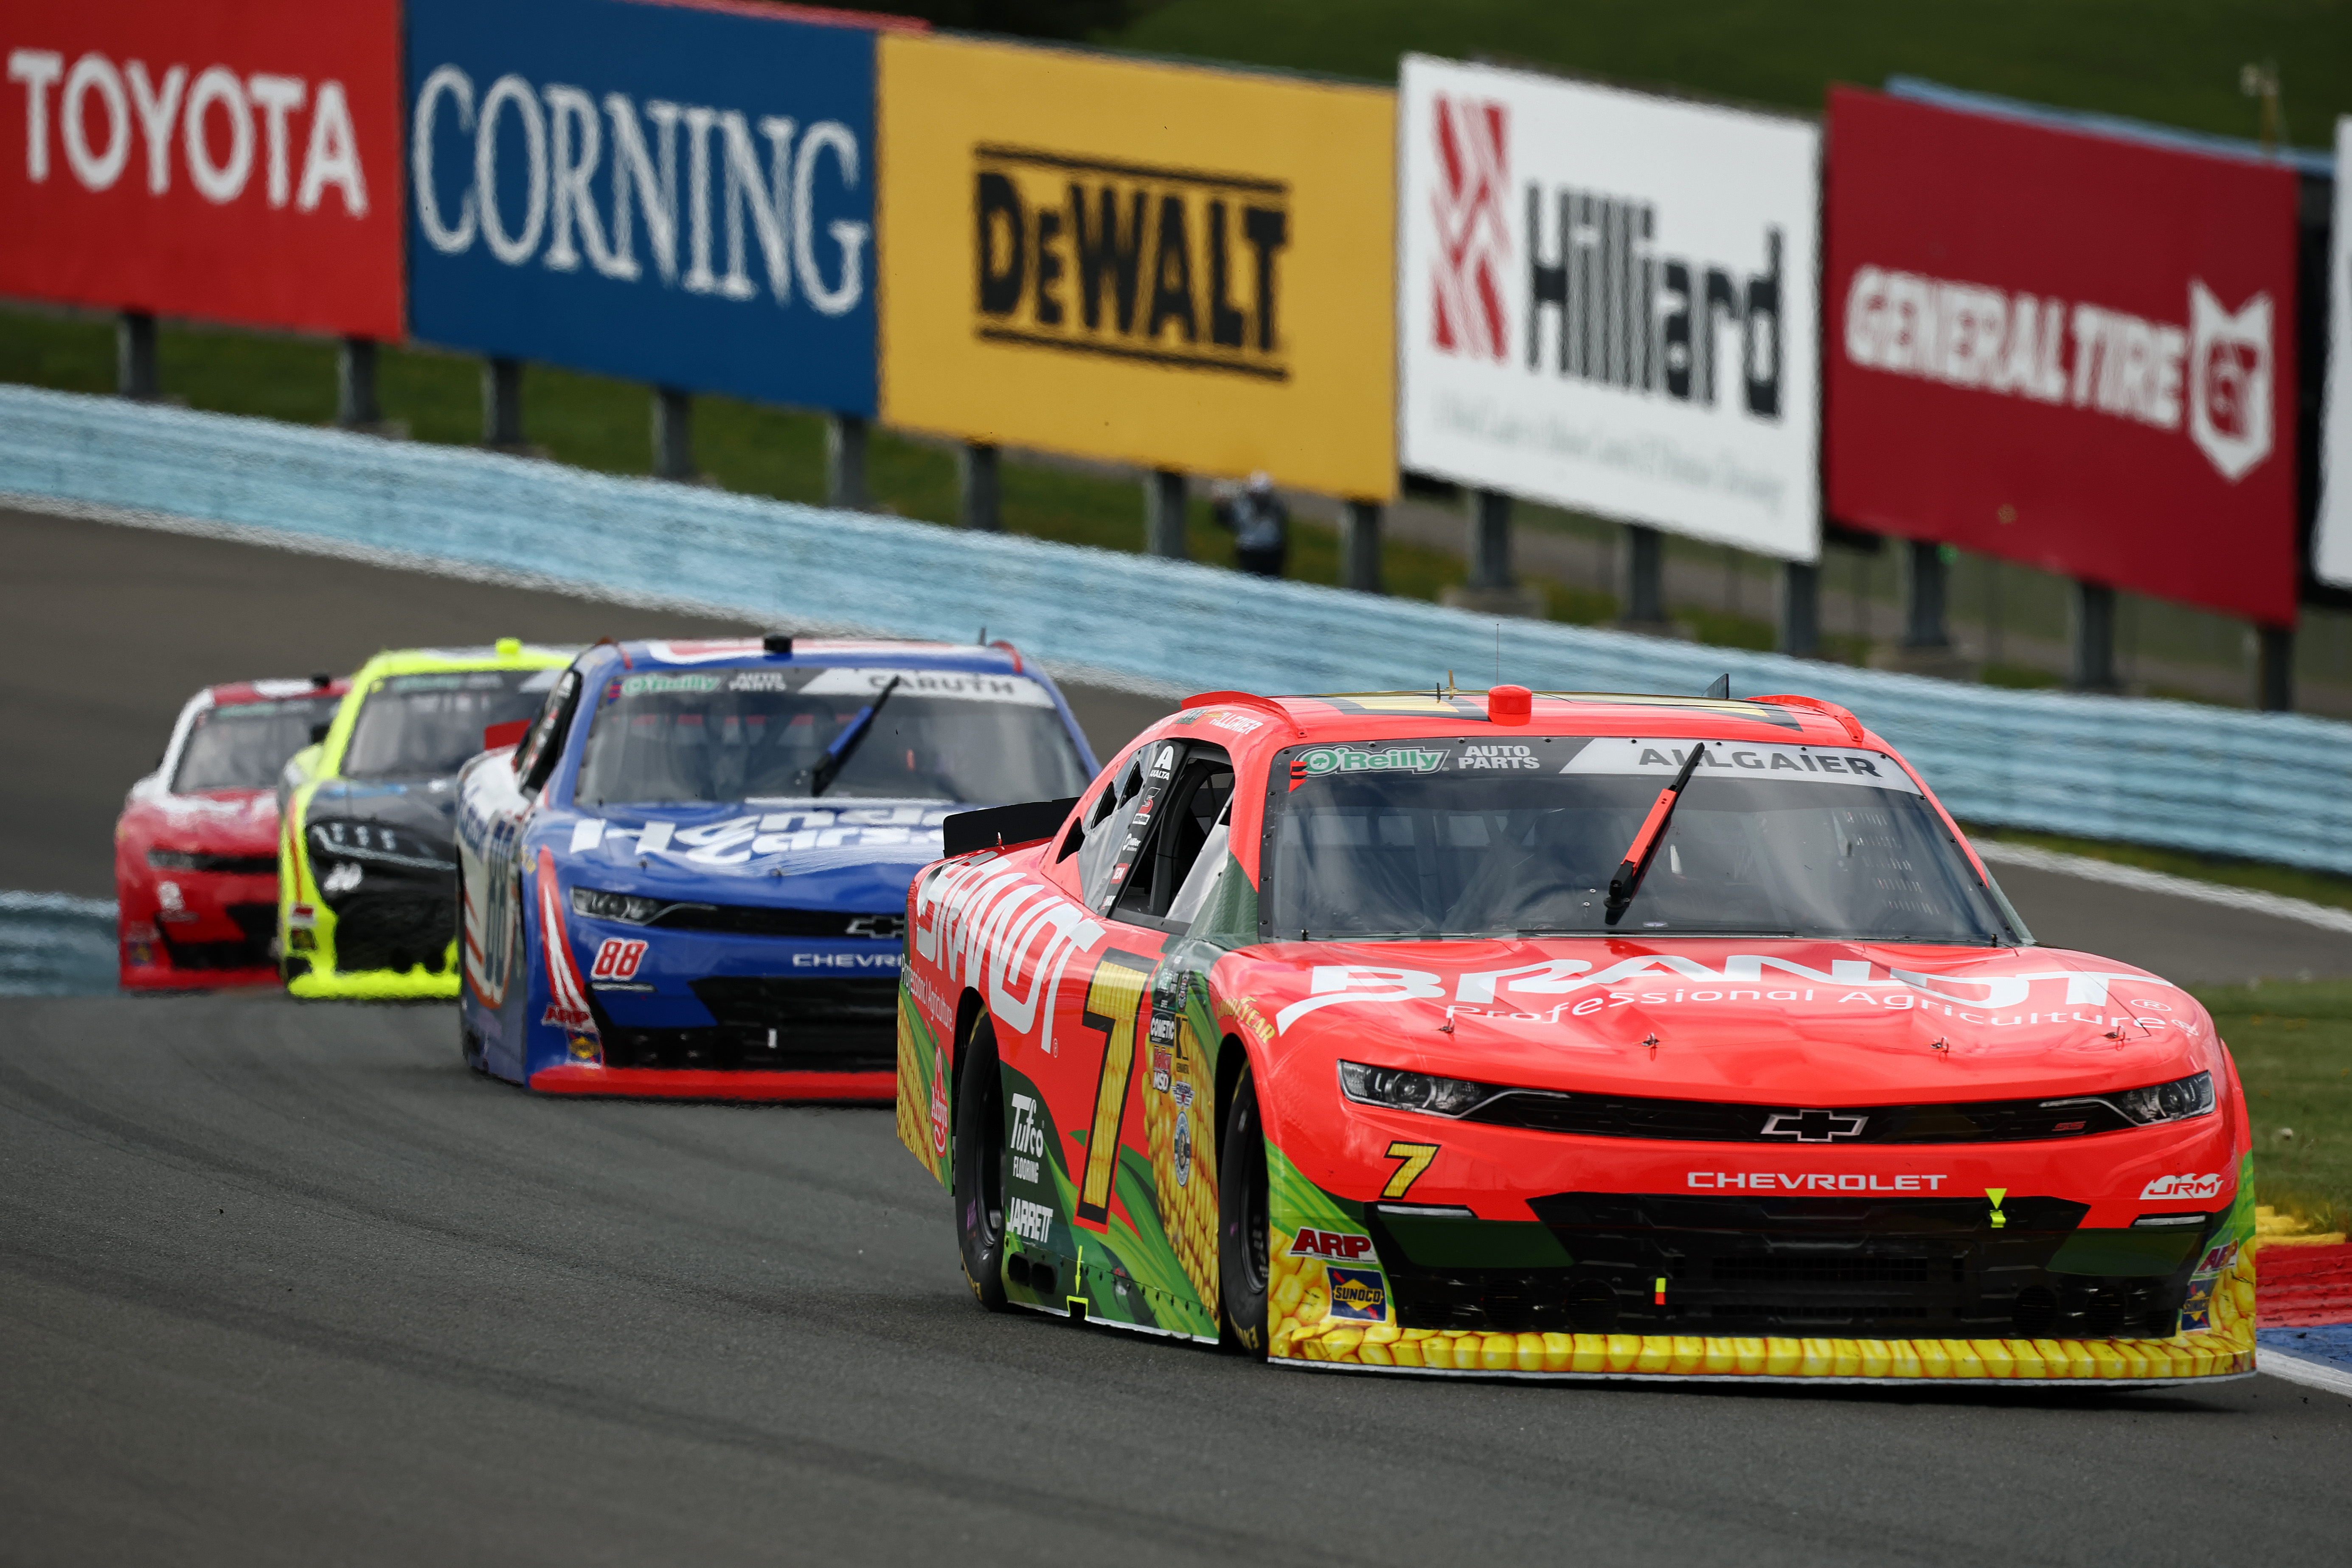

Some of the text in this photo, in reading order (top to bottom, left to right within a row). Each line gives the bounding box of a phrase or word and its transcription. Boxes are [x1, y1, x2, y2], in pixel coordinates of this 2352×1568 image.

[7, 48, 368, 218] TOYOTA
[412, 63, 871, 318] CORNING
[1524, 180, 1786, 425] Hilliard
[1843, 262, 2188, 432] GENERAL TIRE
[868, 674, 1015, 695] CARUTH
[1303, 748, 1442, 773] O'Reilly
[1458, 757, 1540, 769] PARTS
[1464, 745, 1531, 757] AUTO
[1638, 748, 1883, 778] ALLGAIER
[1149, 769, 1170, 781] AXALTA
[590, 938, 649, 981] 88
[1276, 954, 2174, 1037] BRANDT
[1446, 988, 2166, 1029] Professional Agriculture
[1150, 1017, 1175, 1040] COMETIC
[1076, 946, 1159, 1225] 7
[1010, 1093, 1044, 1158] Tufco
[1013, 1155, 1039, 1184] FLOORING
[1378, 1141, 1442, 1200] 7
[1687, 1172, 1947, 1190] CHEVROLET
[2148, 1181, 2217, 1196] JRM
[1006, 1197, 1054, 1243] JARRETT
[1291, 1228, 1371, 1258] ARP
[1335, 1287, 1381, 1303] SUNOCO
